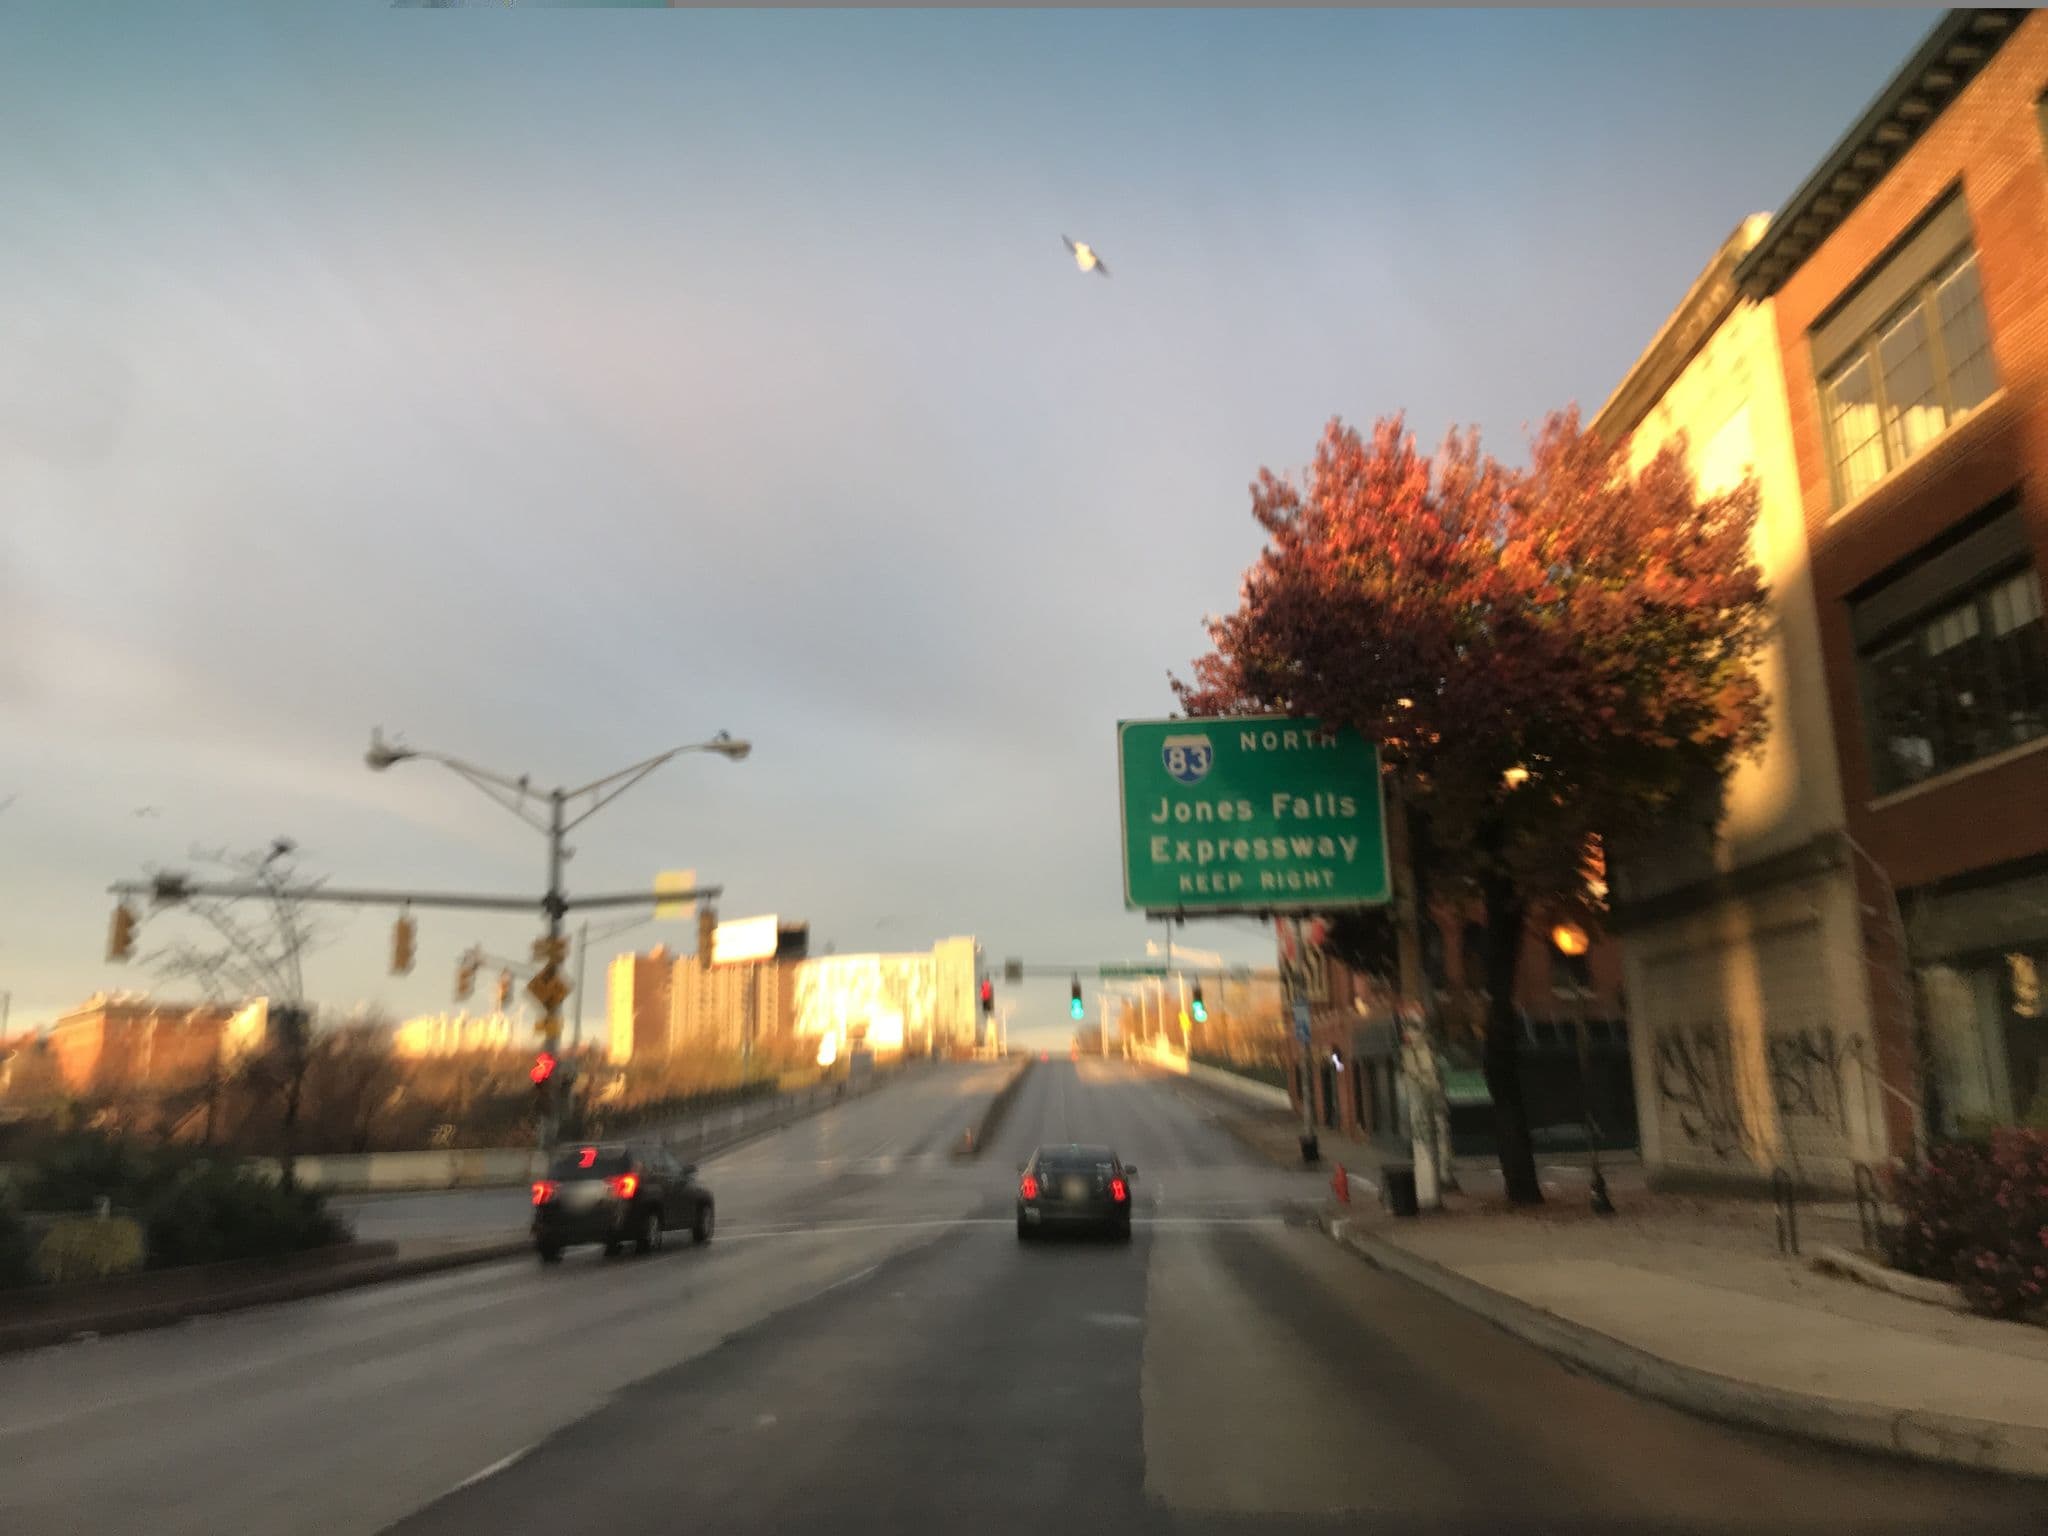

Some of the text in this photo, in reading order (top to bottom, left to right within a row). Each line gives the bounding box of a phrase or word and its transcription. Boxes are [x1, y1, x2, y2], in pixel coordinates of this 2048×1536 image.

[1168, 746, 1209, 776] 83
[1151, 792, 1357, 824] Jones Falls
[1151, 835, 1358, 864] Expressway
[1179, 869, 1335, 893] KEEP RIGHT
